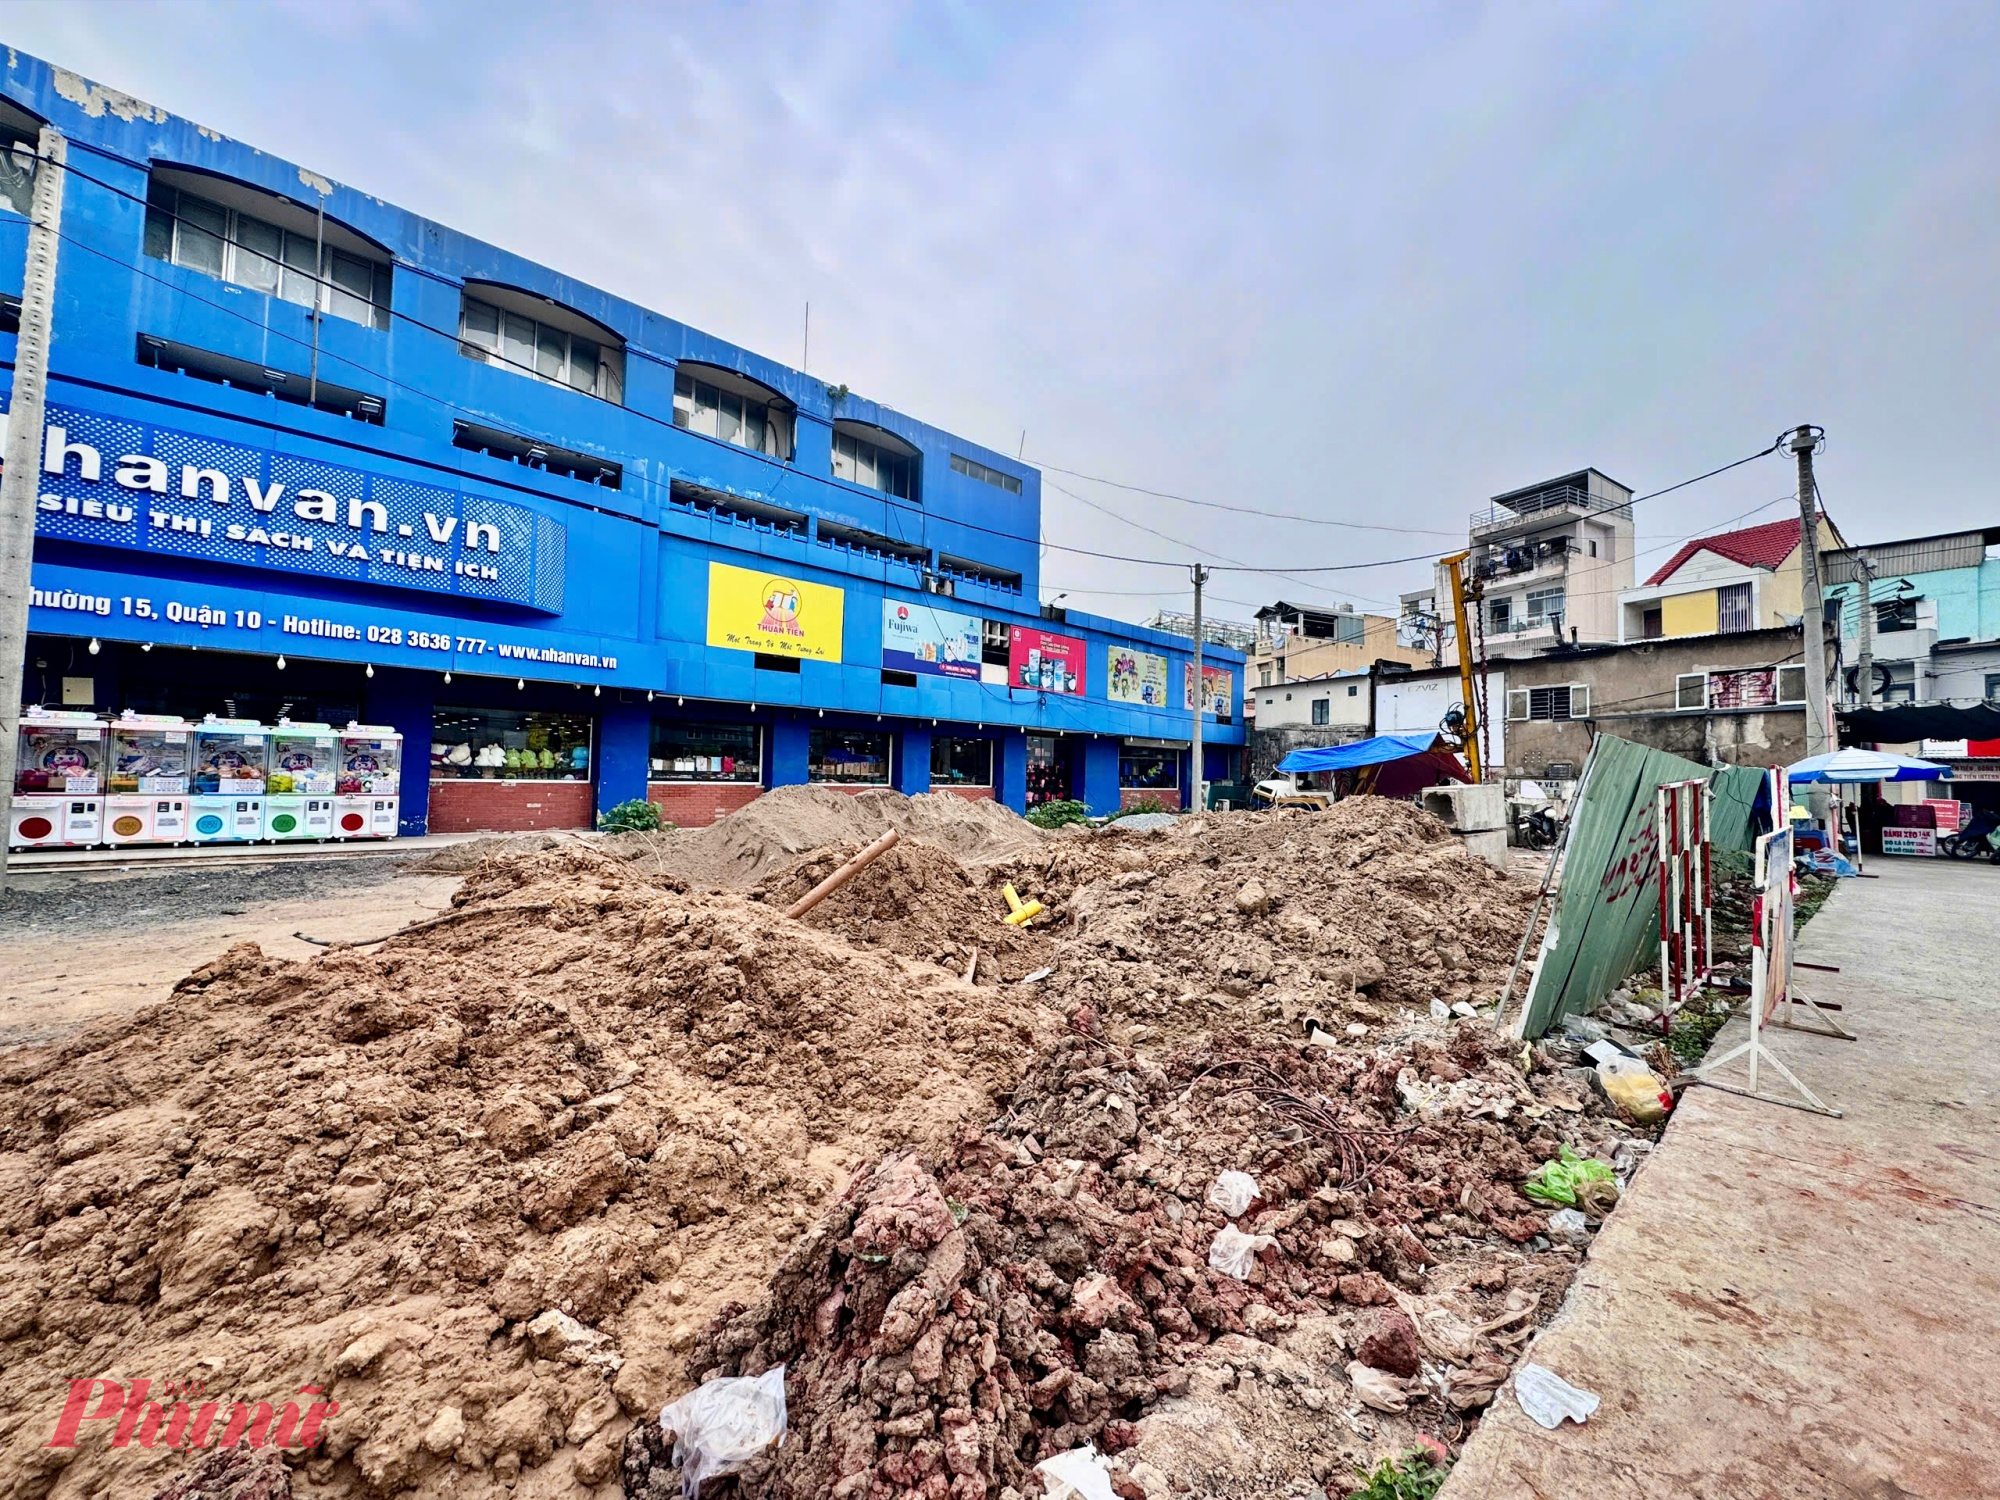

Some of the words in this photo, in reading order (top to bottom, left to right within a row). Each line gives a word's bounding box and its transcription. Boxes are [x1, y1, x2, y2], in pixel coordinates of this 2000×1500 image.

[38, 493, 133, 523] SIÊU
[149, 511, 212, 539] THỊ
[226, 522, 314, 551] SÁCH
[380, 549, 444, 572] TIỆN
[455, 559, 498, 580] ÍCH
[29, 586, 111, 615] hường
[120, 596, 158, 620] 15,
[166, 602, 226, 629] Quận
[234, 610, 262, 629] 10
[283, 614, 362, 641] Hotline:
[367, 625, 403, 645] 028
[407, 630, 451, 651] 3636
[498, 643, 618, 669] www.nhanvan.vn
[888, 618, 918, 634] Fujiwa
